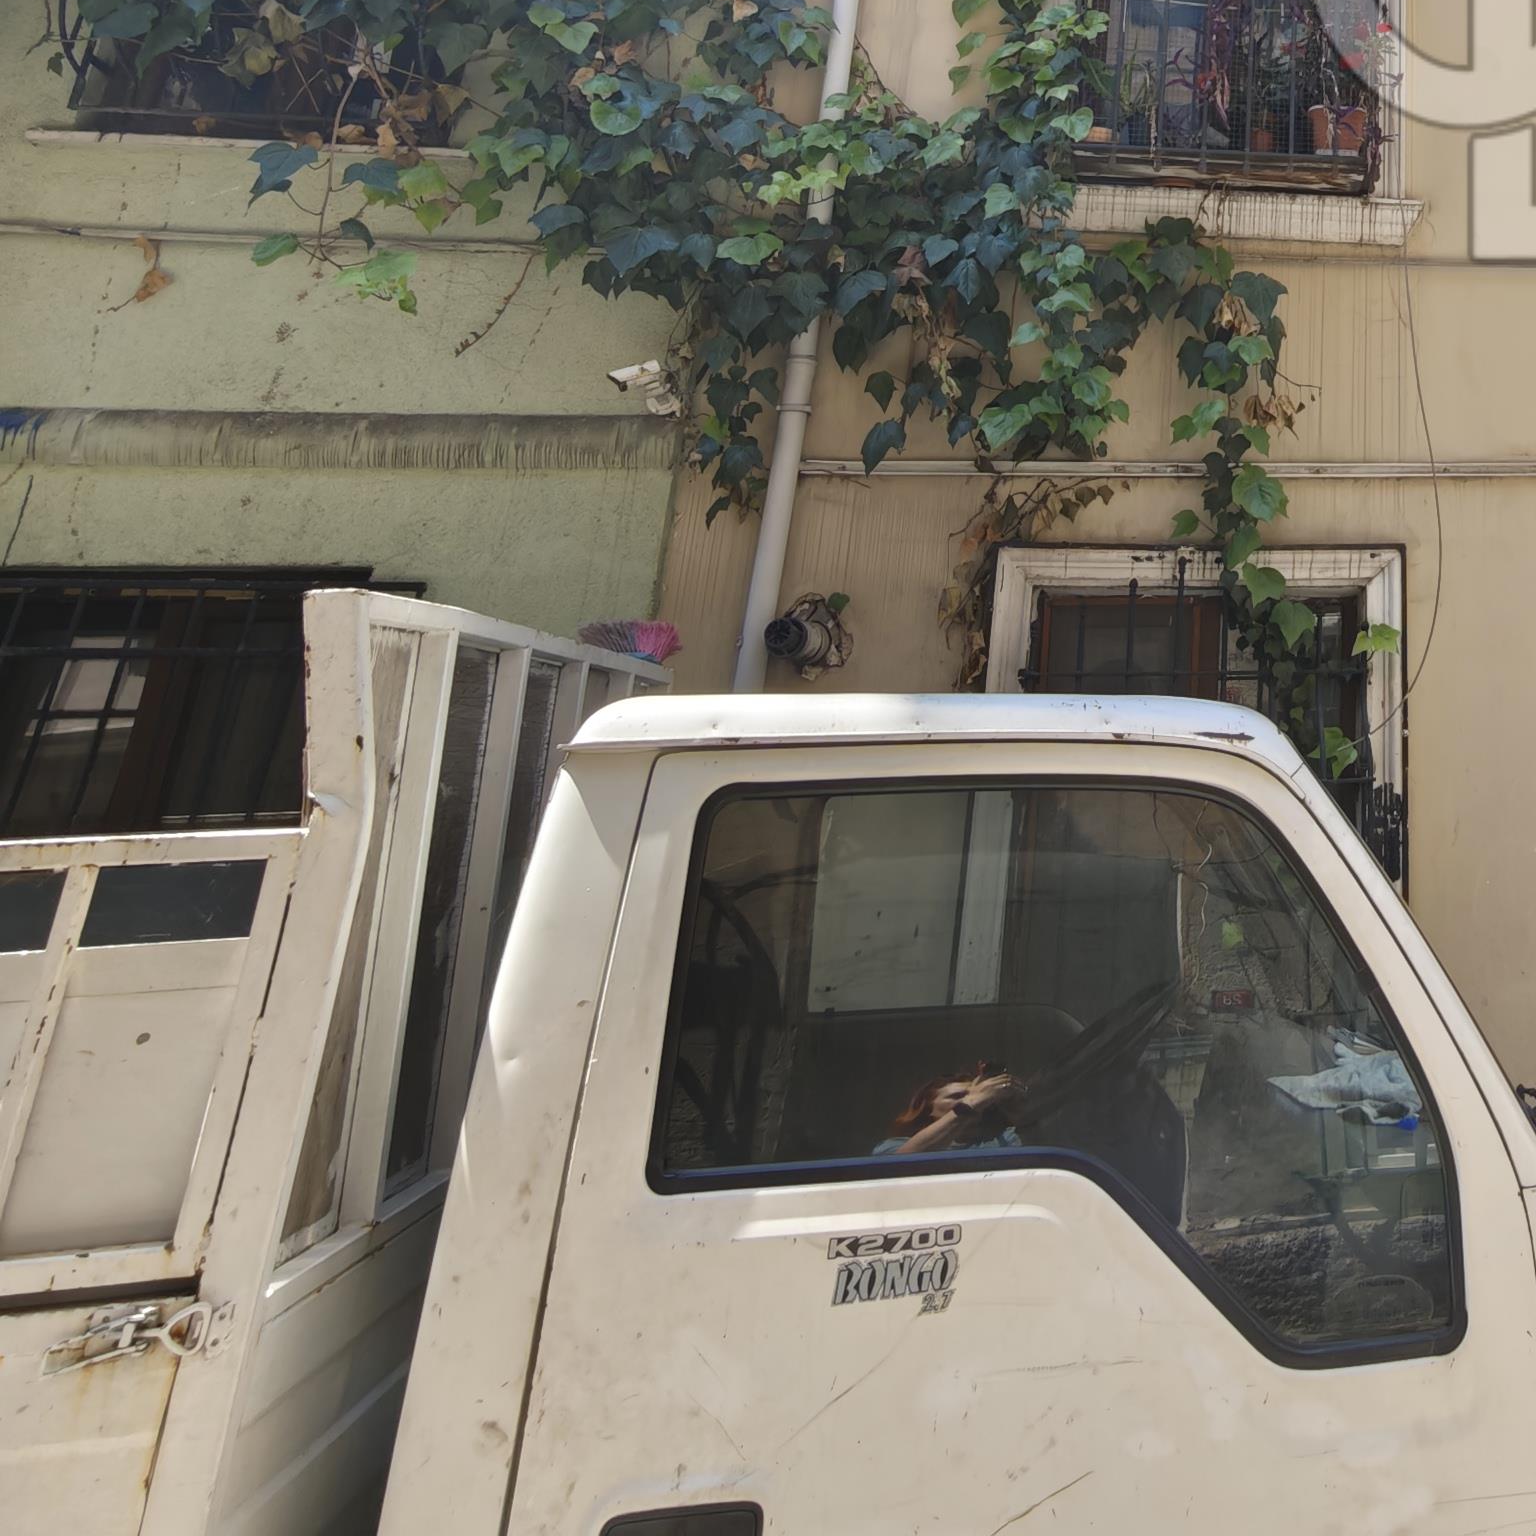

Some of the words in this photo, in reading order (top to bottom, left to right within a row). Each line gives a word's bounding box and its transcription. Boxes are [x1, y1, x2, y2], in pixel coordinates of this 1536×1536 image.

[827, 1223, 962, 1260] K2700
[831, 1249, 960, 1307] BONGO
[919, 1289, 957, 1315] 2.7
